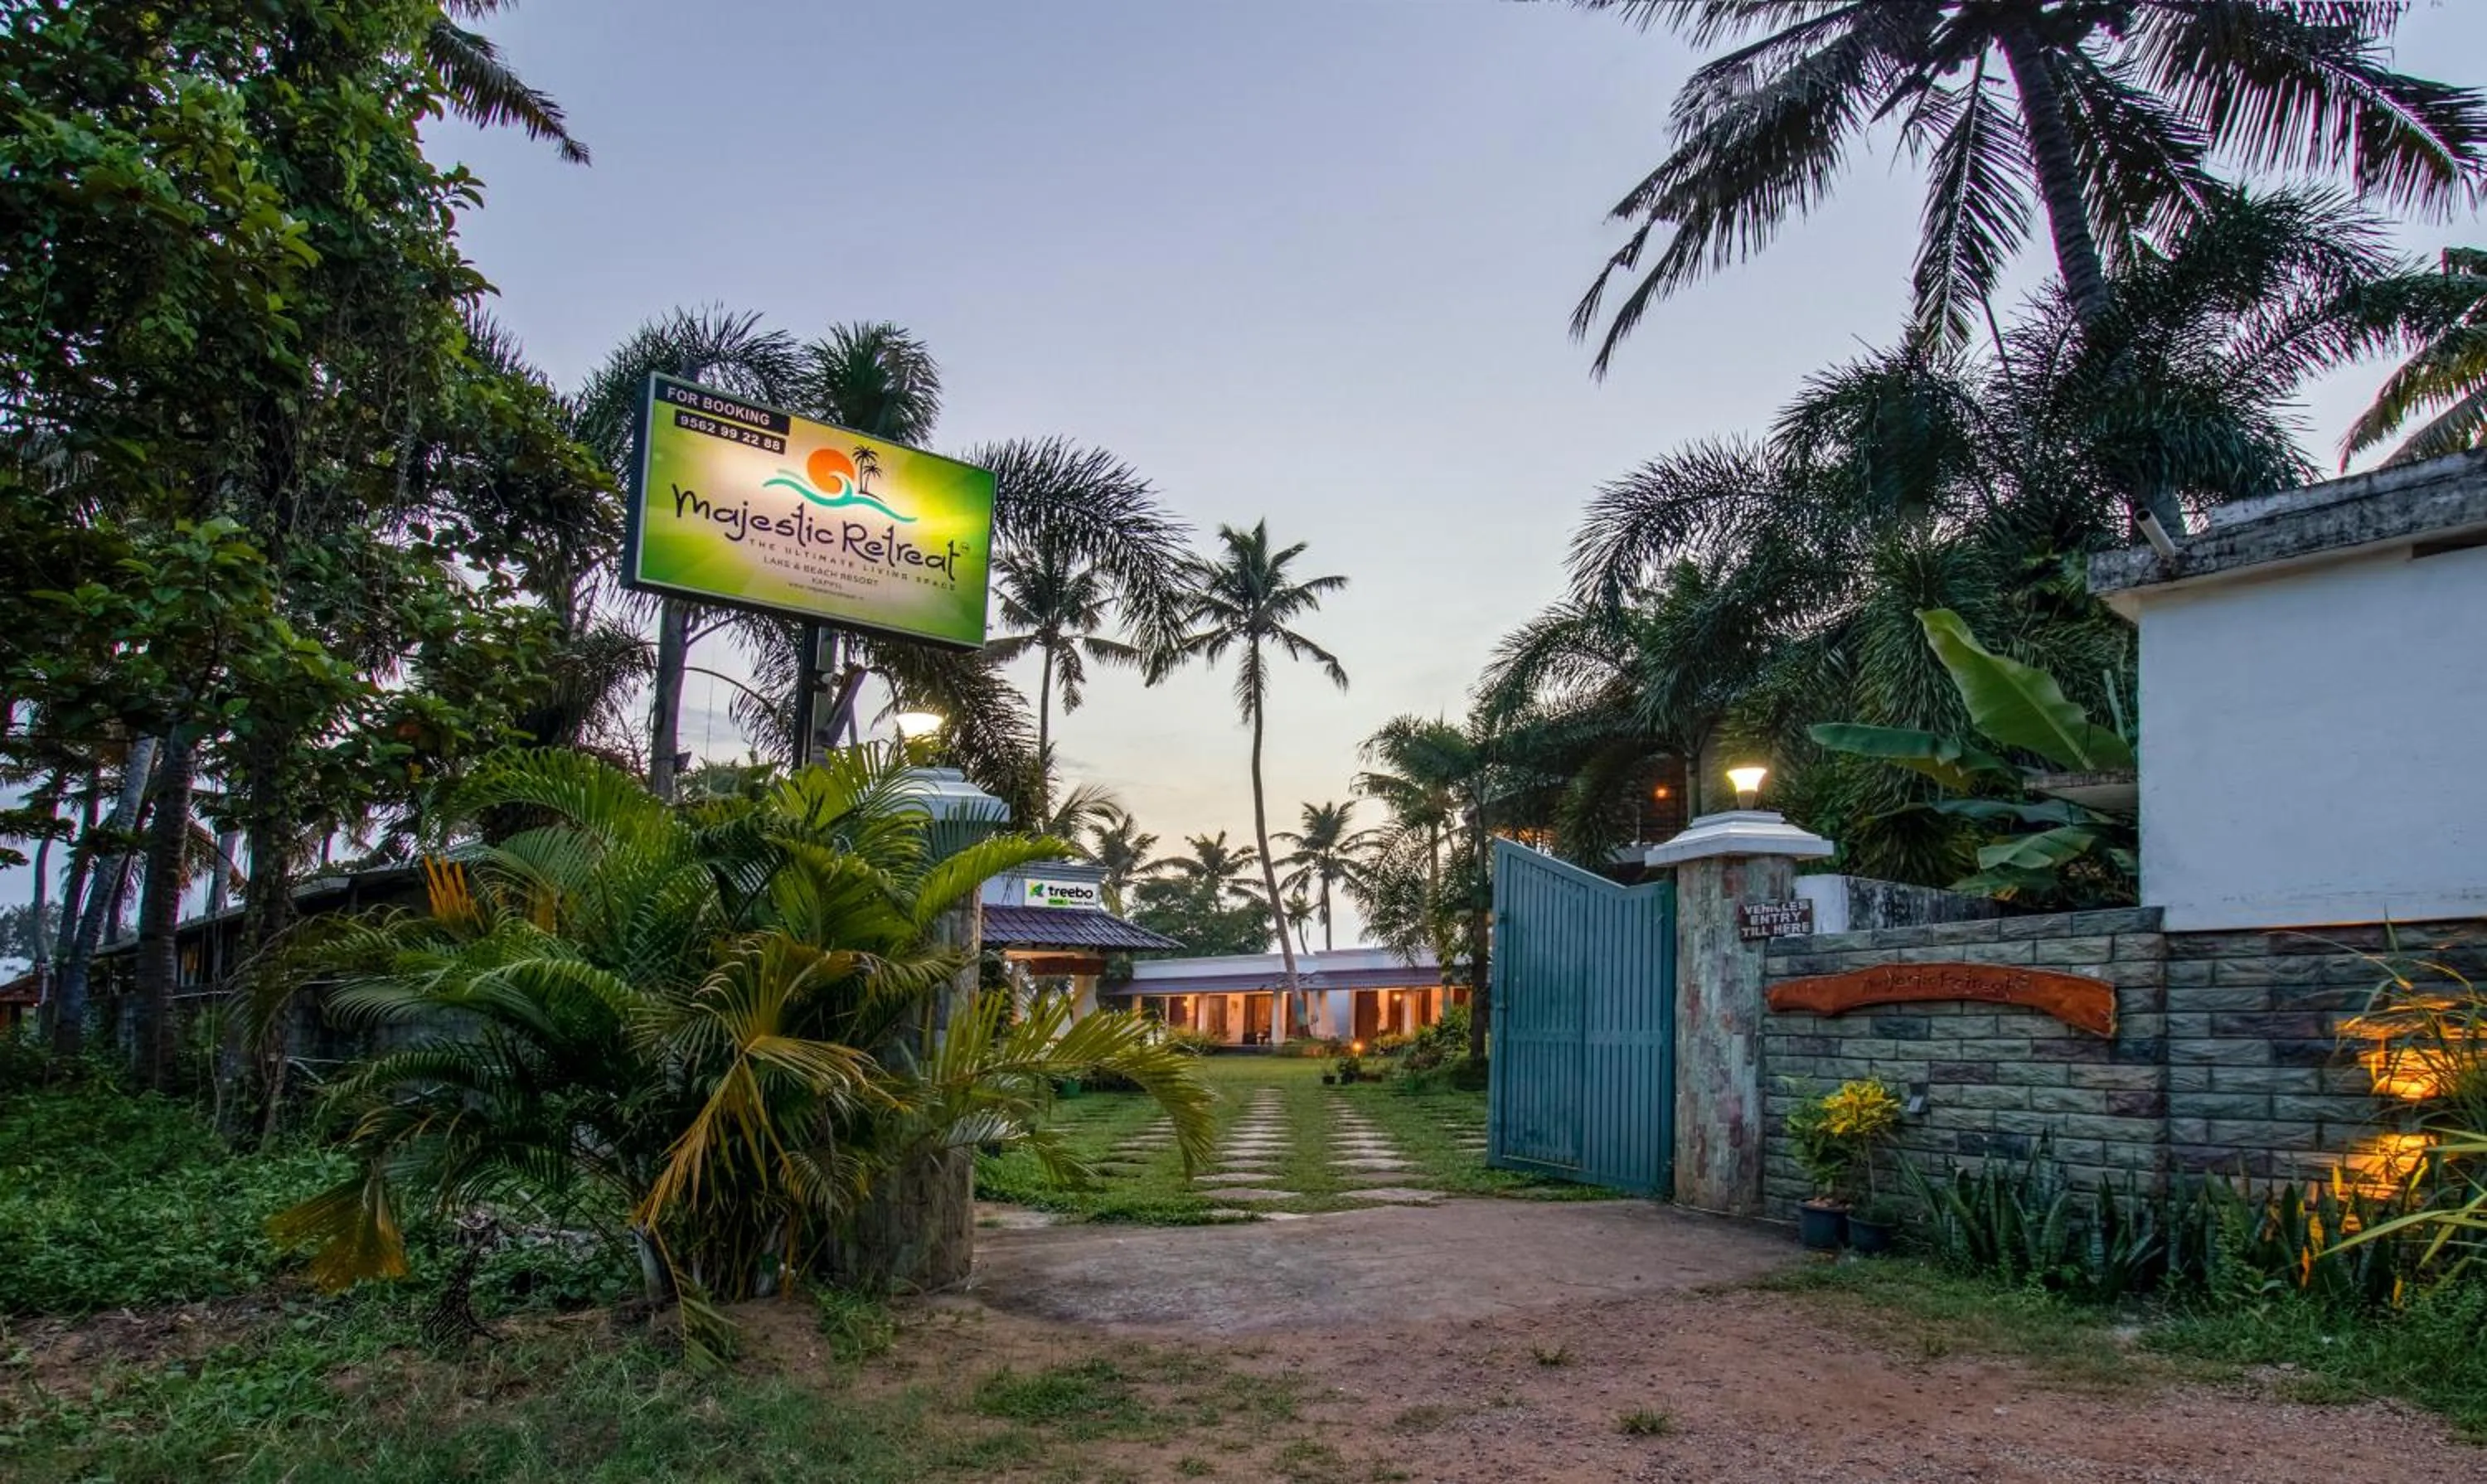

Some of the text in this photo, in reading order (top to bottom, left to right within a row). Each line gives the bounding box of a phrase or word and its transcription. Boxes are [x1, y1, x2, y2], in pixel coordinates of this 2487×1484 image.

[667, 386, 771, 426] FOR BOOKING
[680, 415, 716, 434] 9562
[720, 426, 738, 439] 99
[742, 432, 759, 445] 22
[749, 539, 776, 550] THE
[784, 546, 855, 568] ULTIMATE
[841, 520, 961, 581] Retreat
[803, 565, 838, 578] BEACH
[1048, 886, 1093, 900] treebo
[1741, 922, 1810, 937] TILL HERE
[1750, 912, 1801, 925] ENTRY
